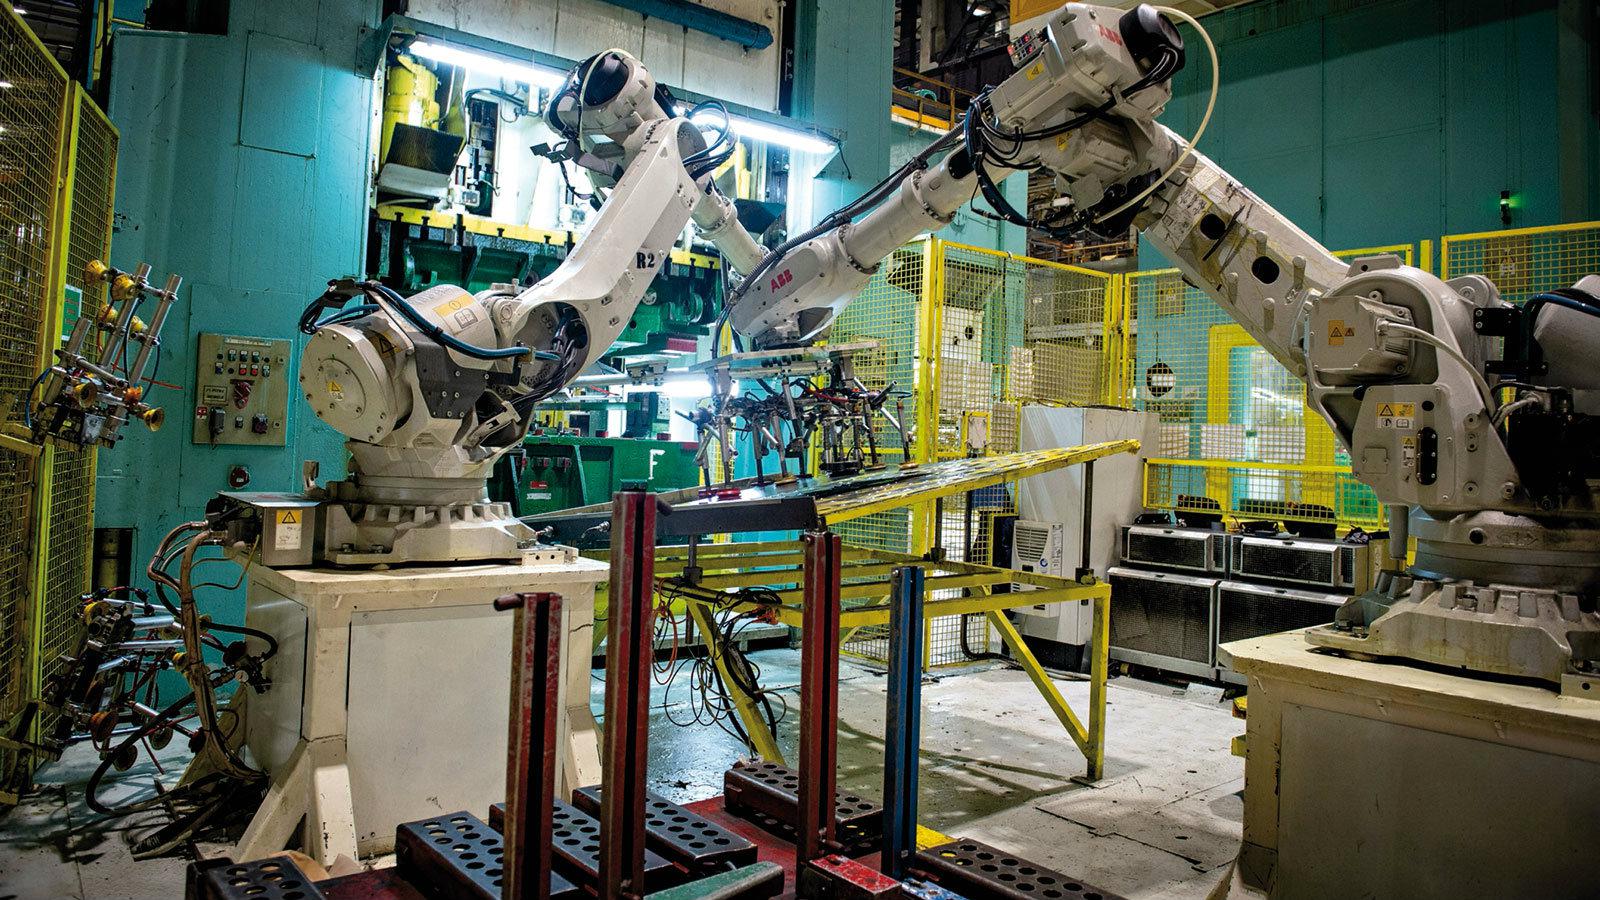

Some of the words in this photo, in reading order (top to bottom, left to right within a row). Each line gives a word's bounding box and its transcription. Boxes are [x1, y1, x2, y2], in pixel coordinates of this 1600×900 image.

[636, 252, 655, 269] R2
[770, 269, 793, 293] ABB
[649, 449, 666, 480] F
